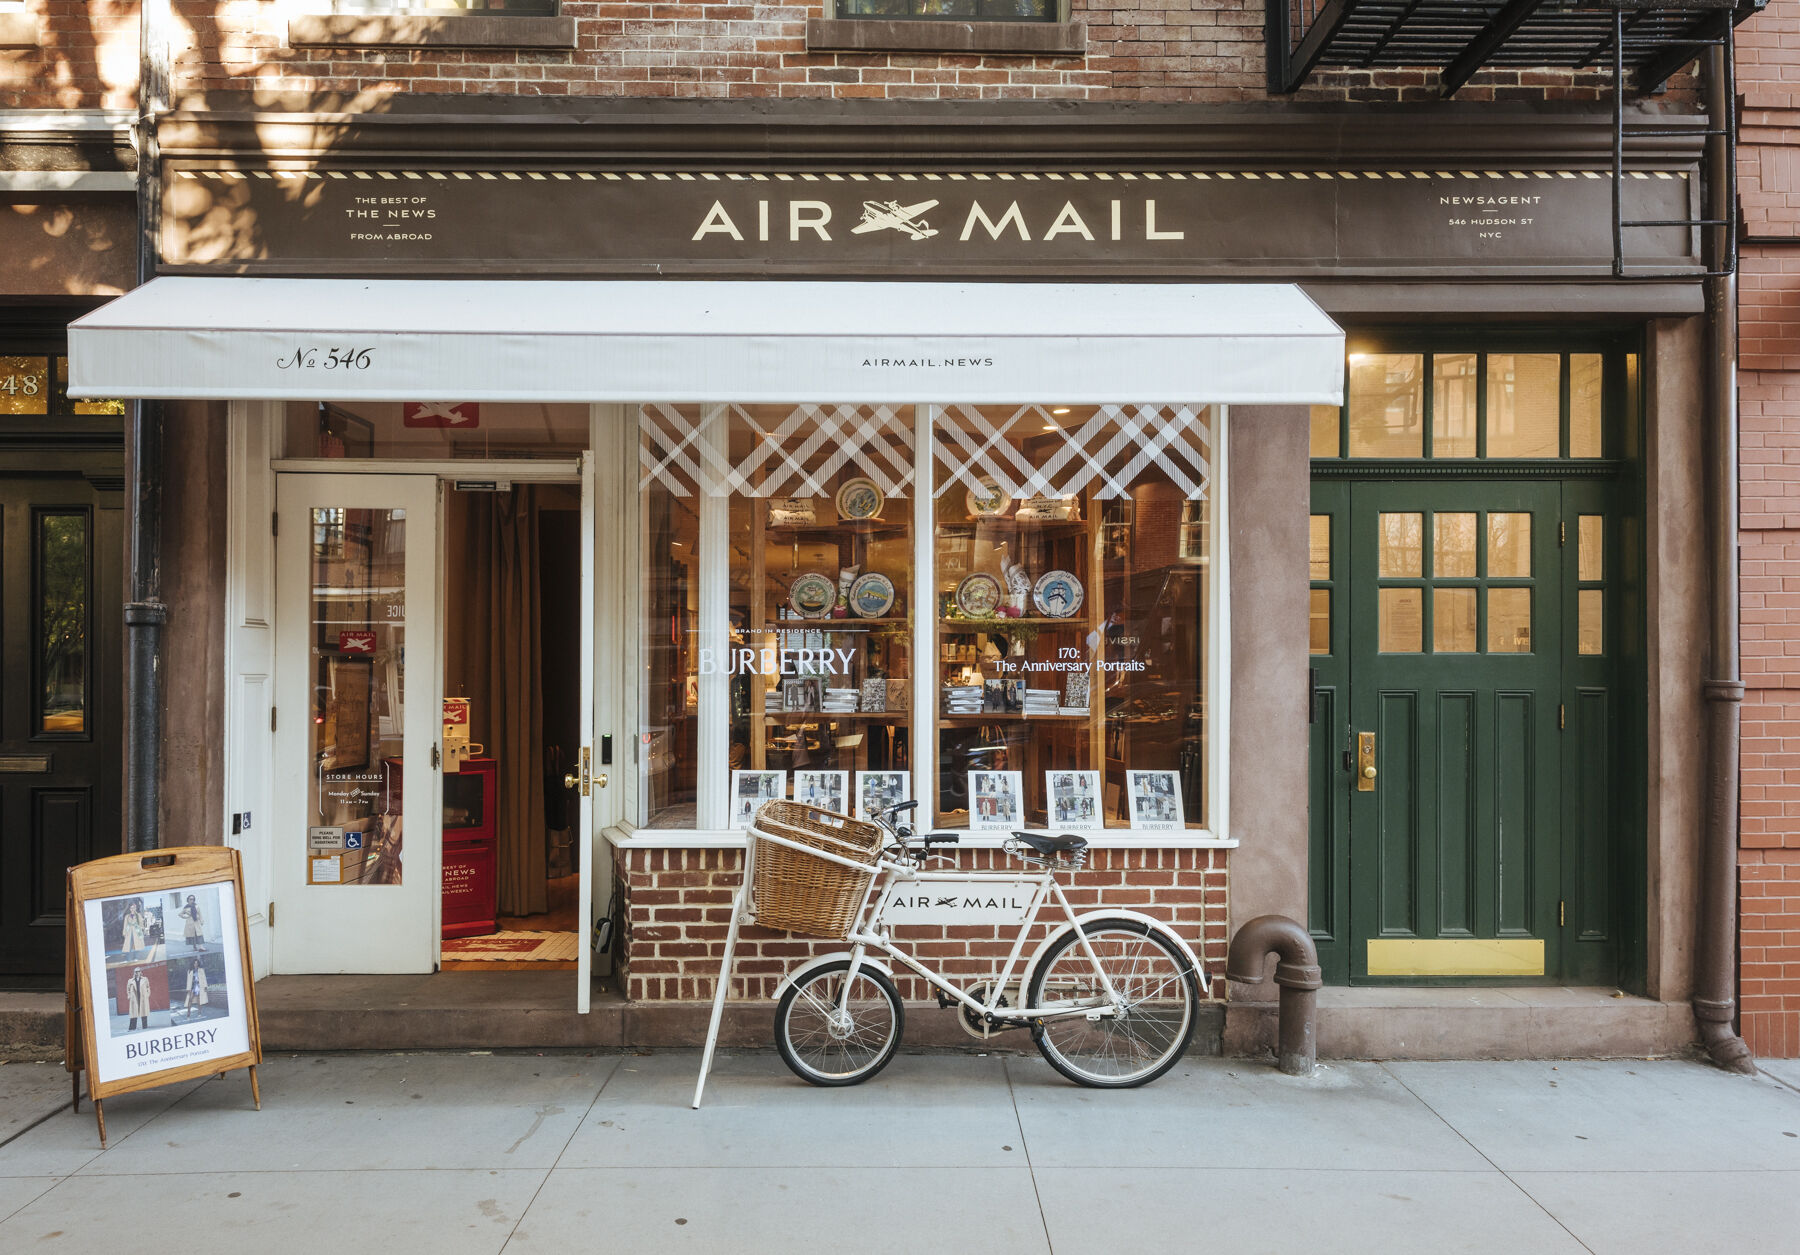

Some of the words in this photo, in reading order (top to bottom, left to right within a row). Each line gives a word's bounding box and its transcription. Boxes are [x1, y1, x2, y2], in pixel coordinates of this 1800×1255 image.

[1440, 196, 1541, 205] NEWSAGENT
[345, 209, 379, 218] THE
[388, 209, 436, 218] NEWS
[691, 199, 833, 241] AIR
[959, 199, 1185, 241] MAIL
[323, 346, 376, 370] 546
[862, 358, 993, 367] AIRMAIL.NEWS
[1057, 647, 1081, 659] 170:
[699, 648, 857, 675] BURBERRY
[992, 660, 1017, 672] The
[1021, 660, 1092, 674] Anniversary
[1096, 659, 1145, 672] Portraits
[892, 896, 931, 908] AIR
[963, 897, 1023, 909] MAIL
[126, 1027, 218, 1060] BURBERRY
